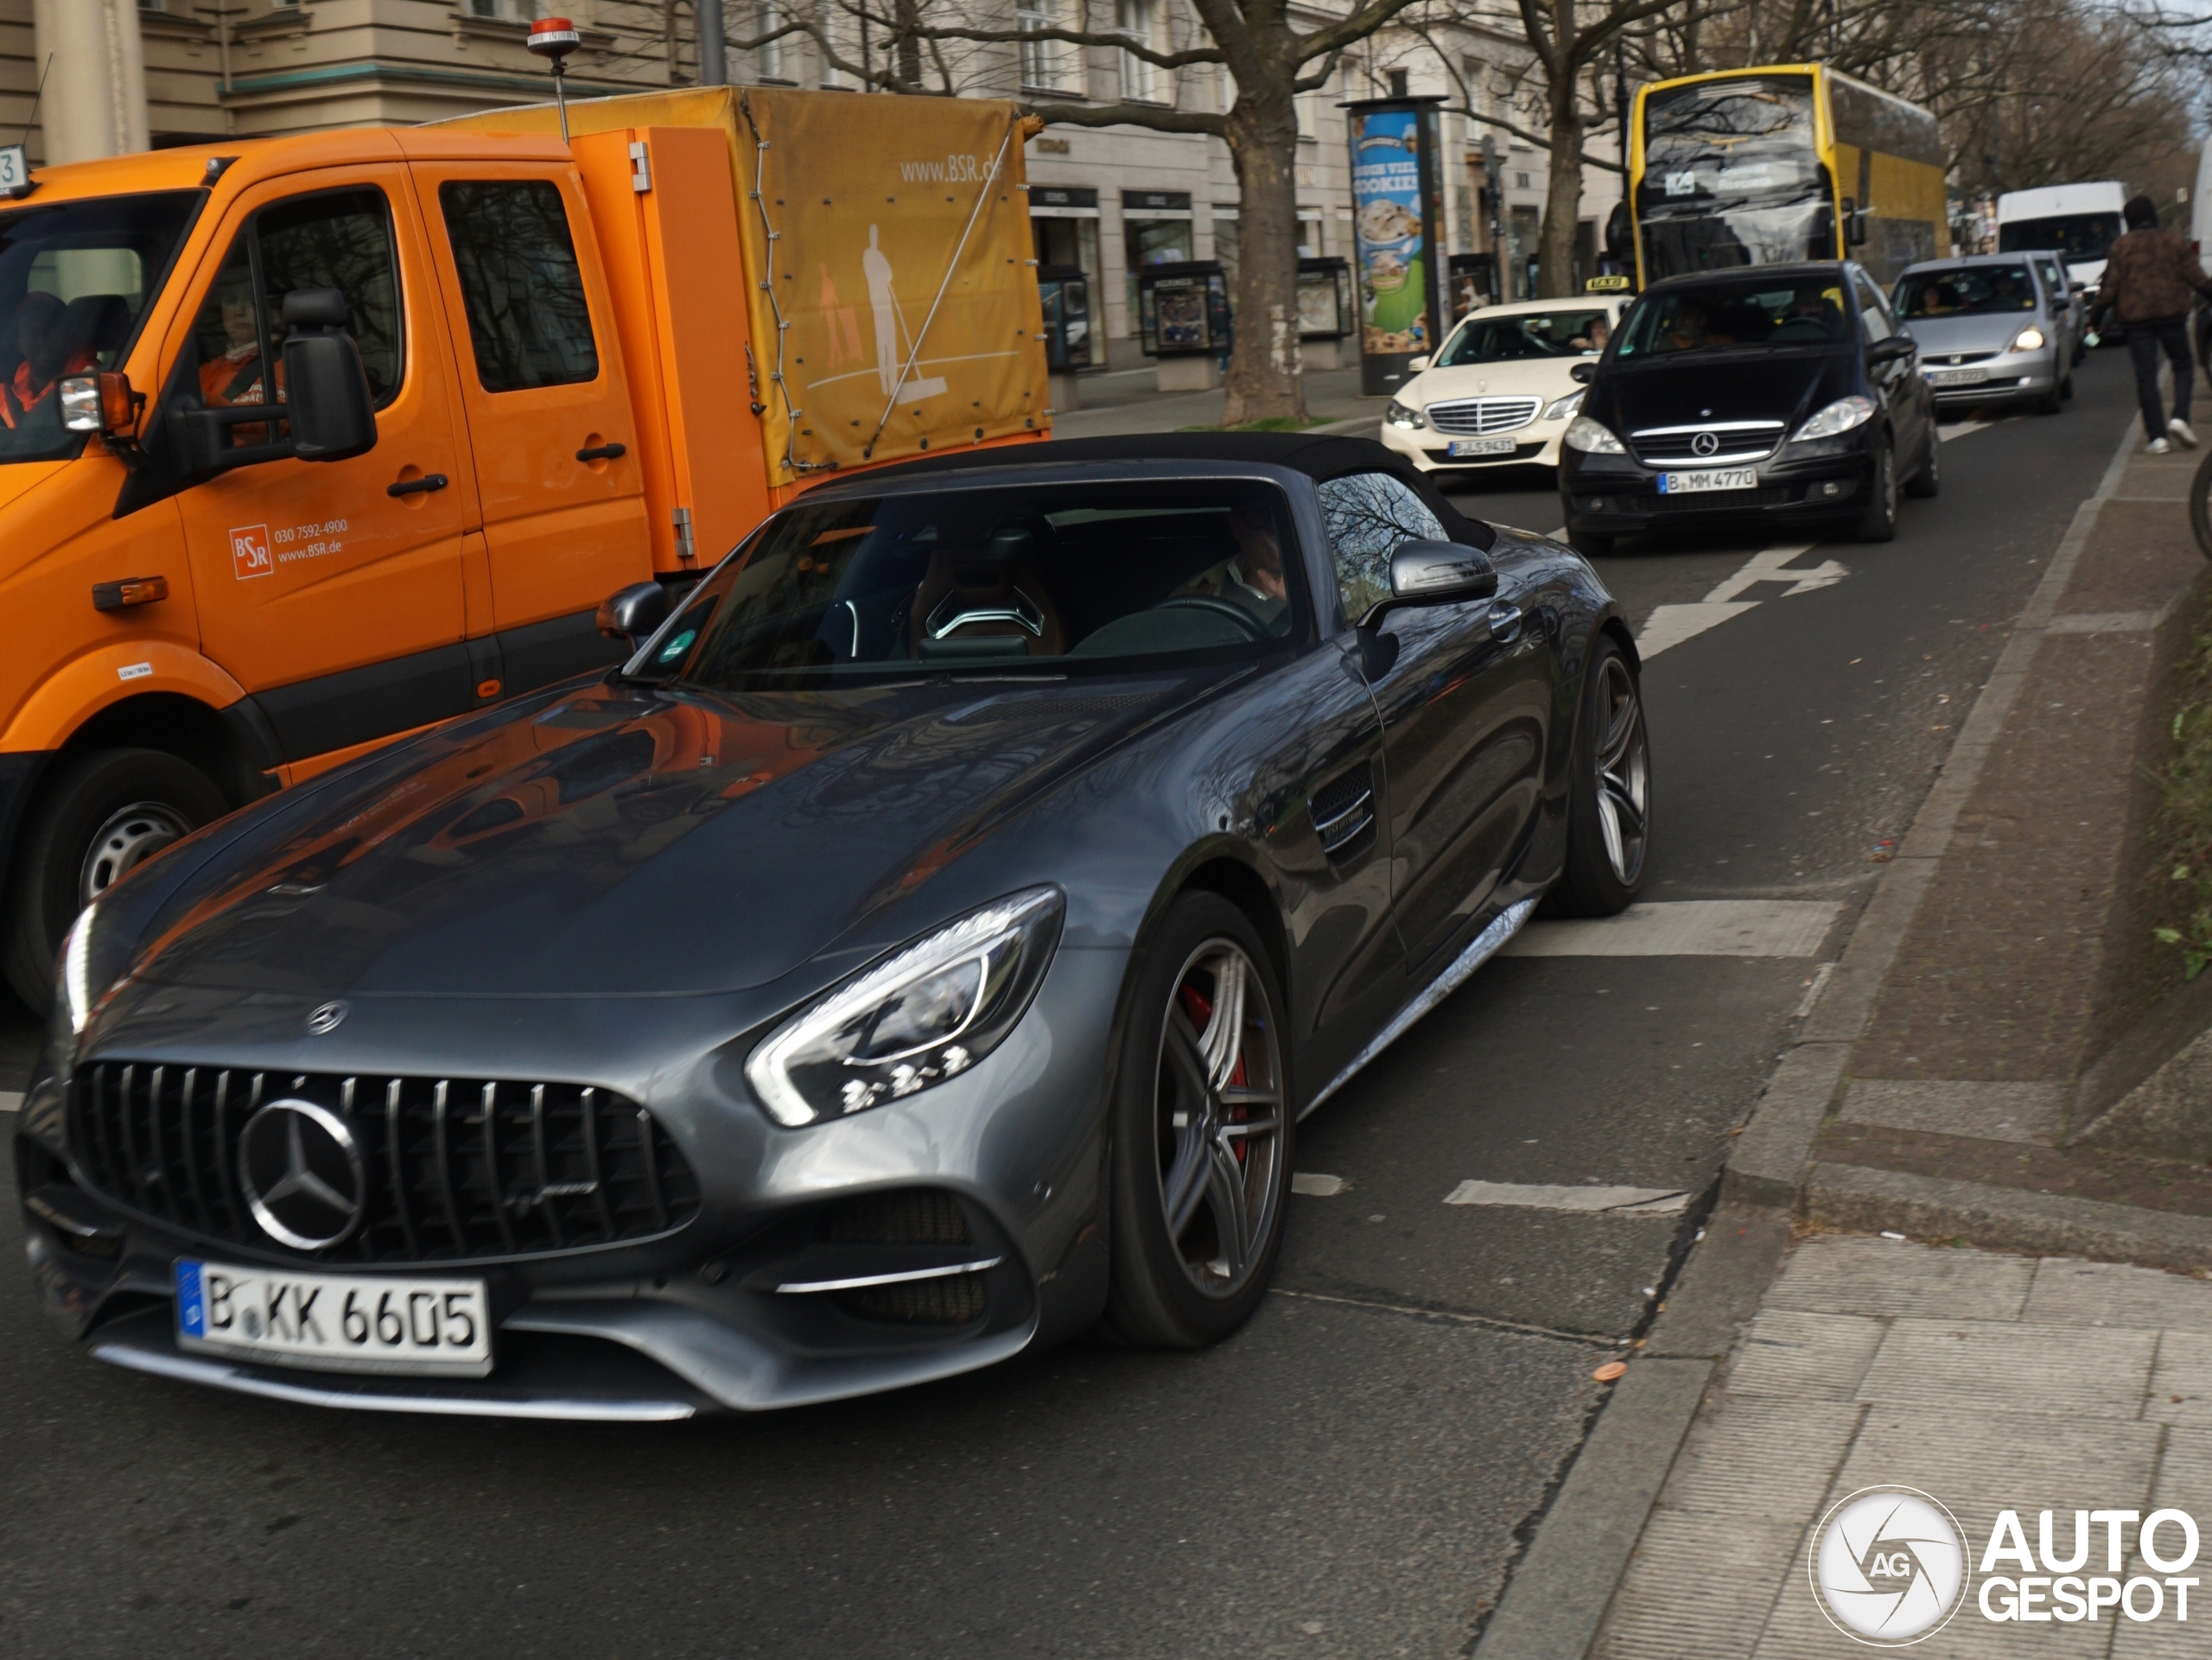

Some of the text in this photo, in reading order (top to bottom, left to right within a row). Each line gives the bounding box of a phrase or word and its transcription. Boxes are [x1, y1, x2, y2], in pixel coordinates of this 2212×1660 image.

[1669, 470, 1753, 490] B MM 4770
[274, 519, 347, 544] 030 7592-4900
[235, 537, 269, 568] BSR
[278, 540, 342, 563] www.BSR.de
[208, 1276, 474, 1347] B KK 6605
